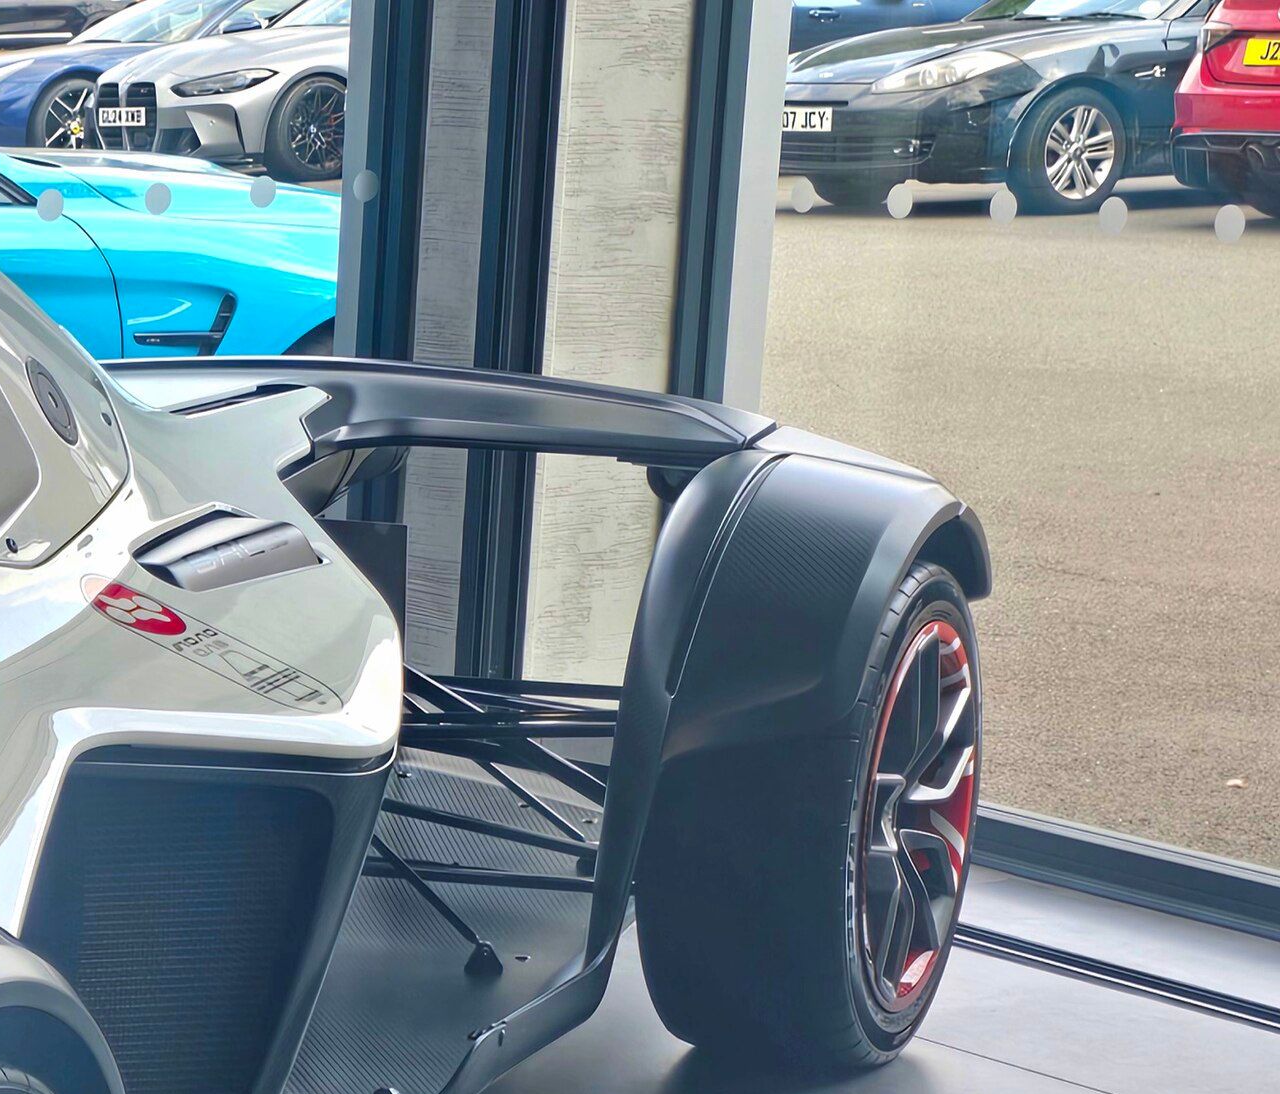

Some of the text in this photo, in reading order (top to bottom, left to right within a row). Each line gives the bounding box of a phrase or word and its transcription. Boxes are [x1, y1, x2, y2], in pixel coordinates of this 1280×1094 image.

[1260, 41, 1280, 60] J2
[782, 111, 826, 129] 07 JCY
